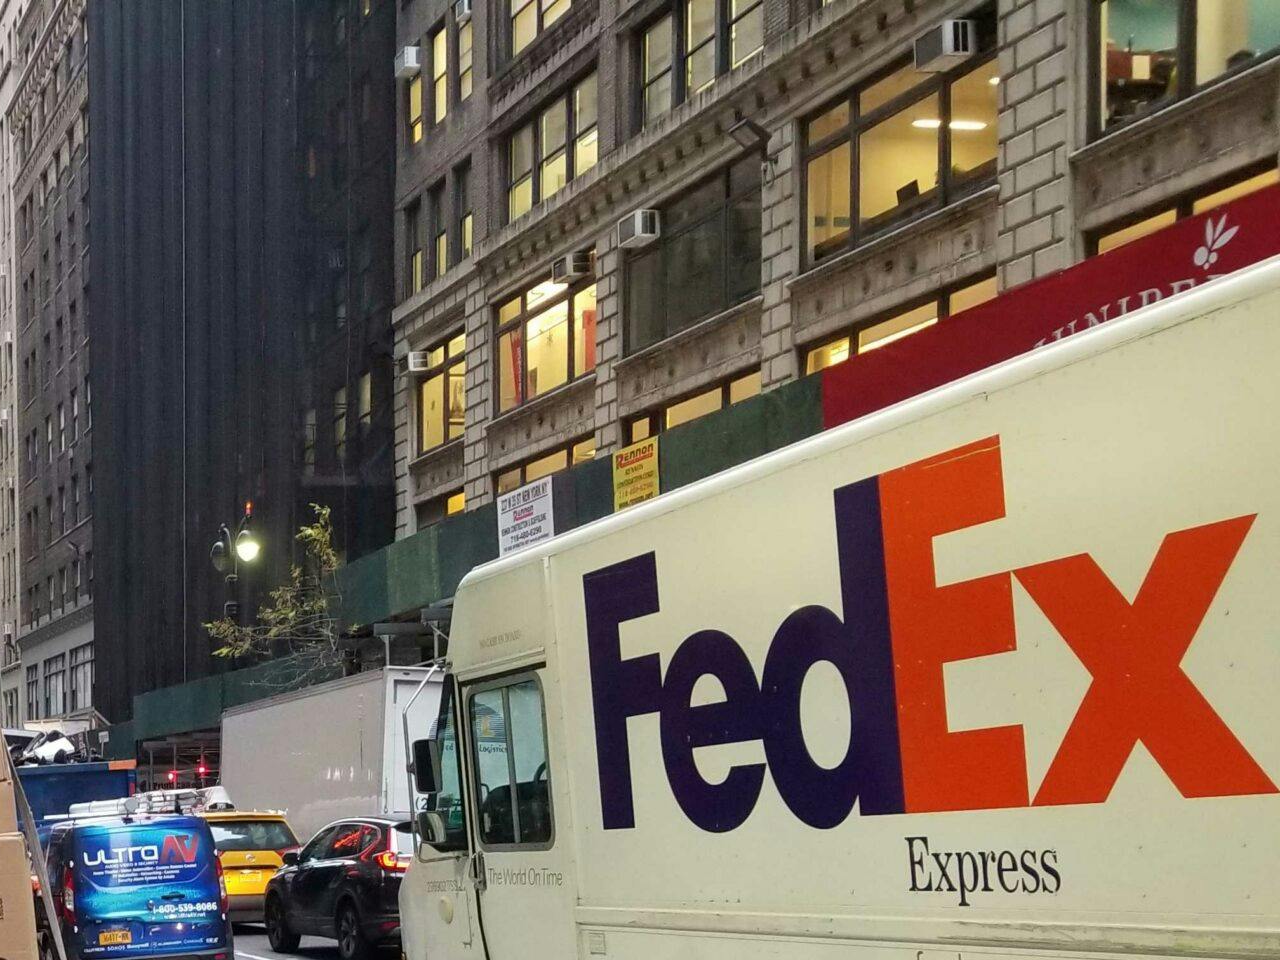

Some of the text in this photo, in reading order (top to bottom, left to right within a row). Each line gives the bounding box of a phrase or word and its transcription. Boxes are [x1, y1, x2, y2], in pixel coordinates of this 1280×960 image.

[582, 434, 1280, 834] FedEx
[488, 868, 563, 886] The World On Time
[904, 836, 1062, 906] Express
